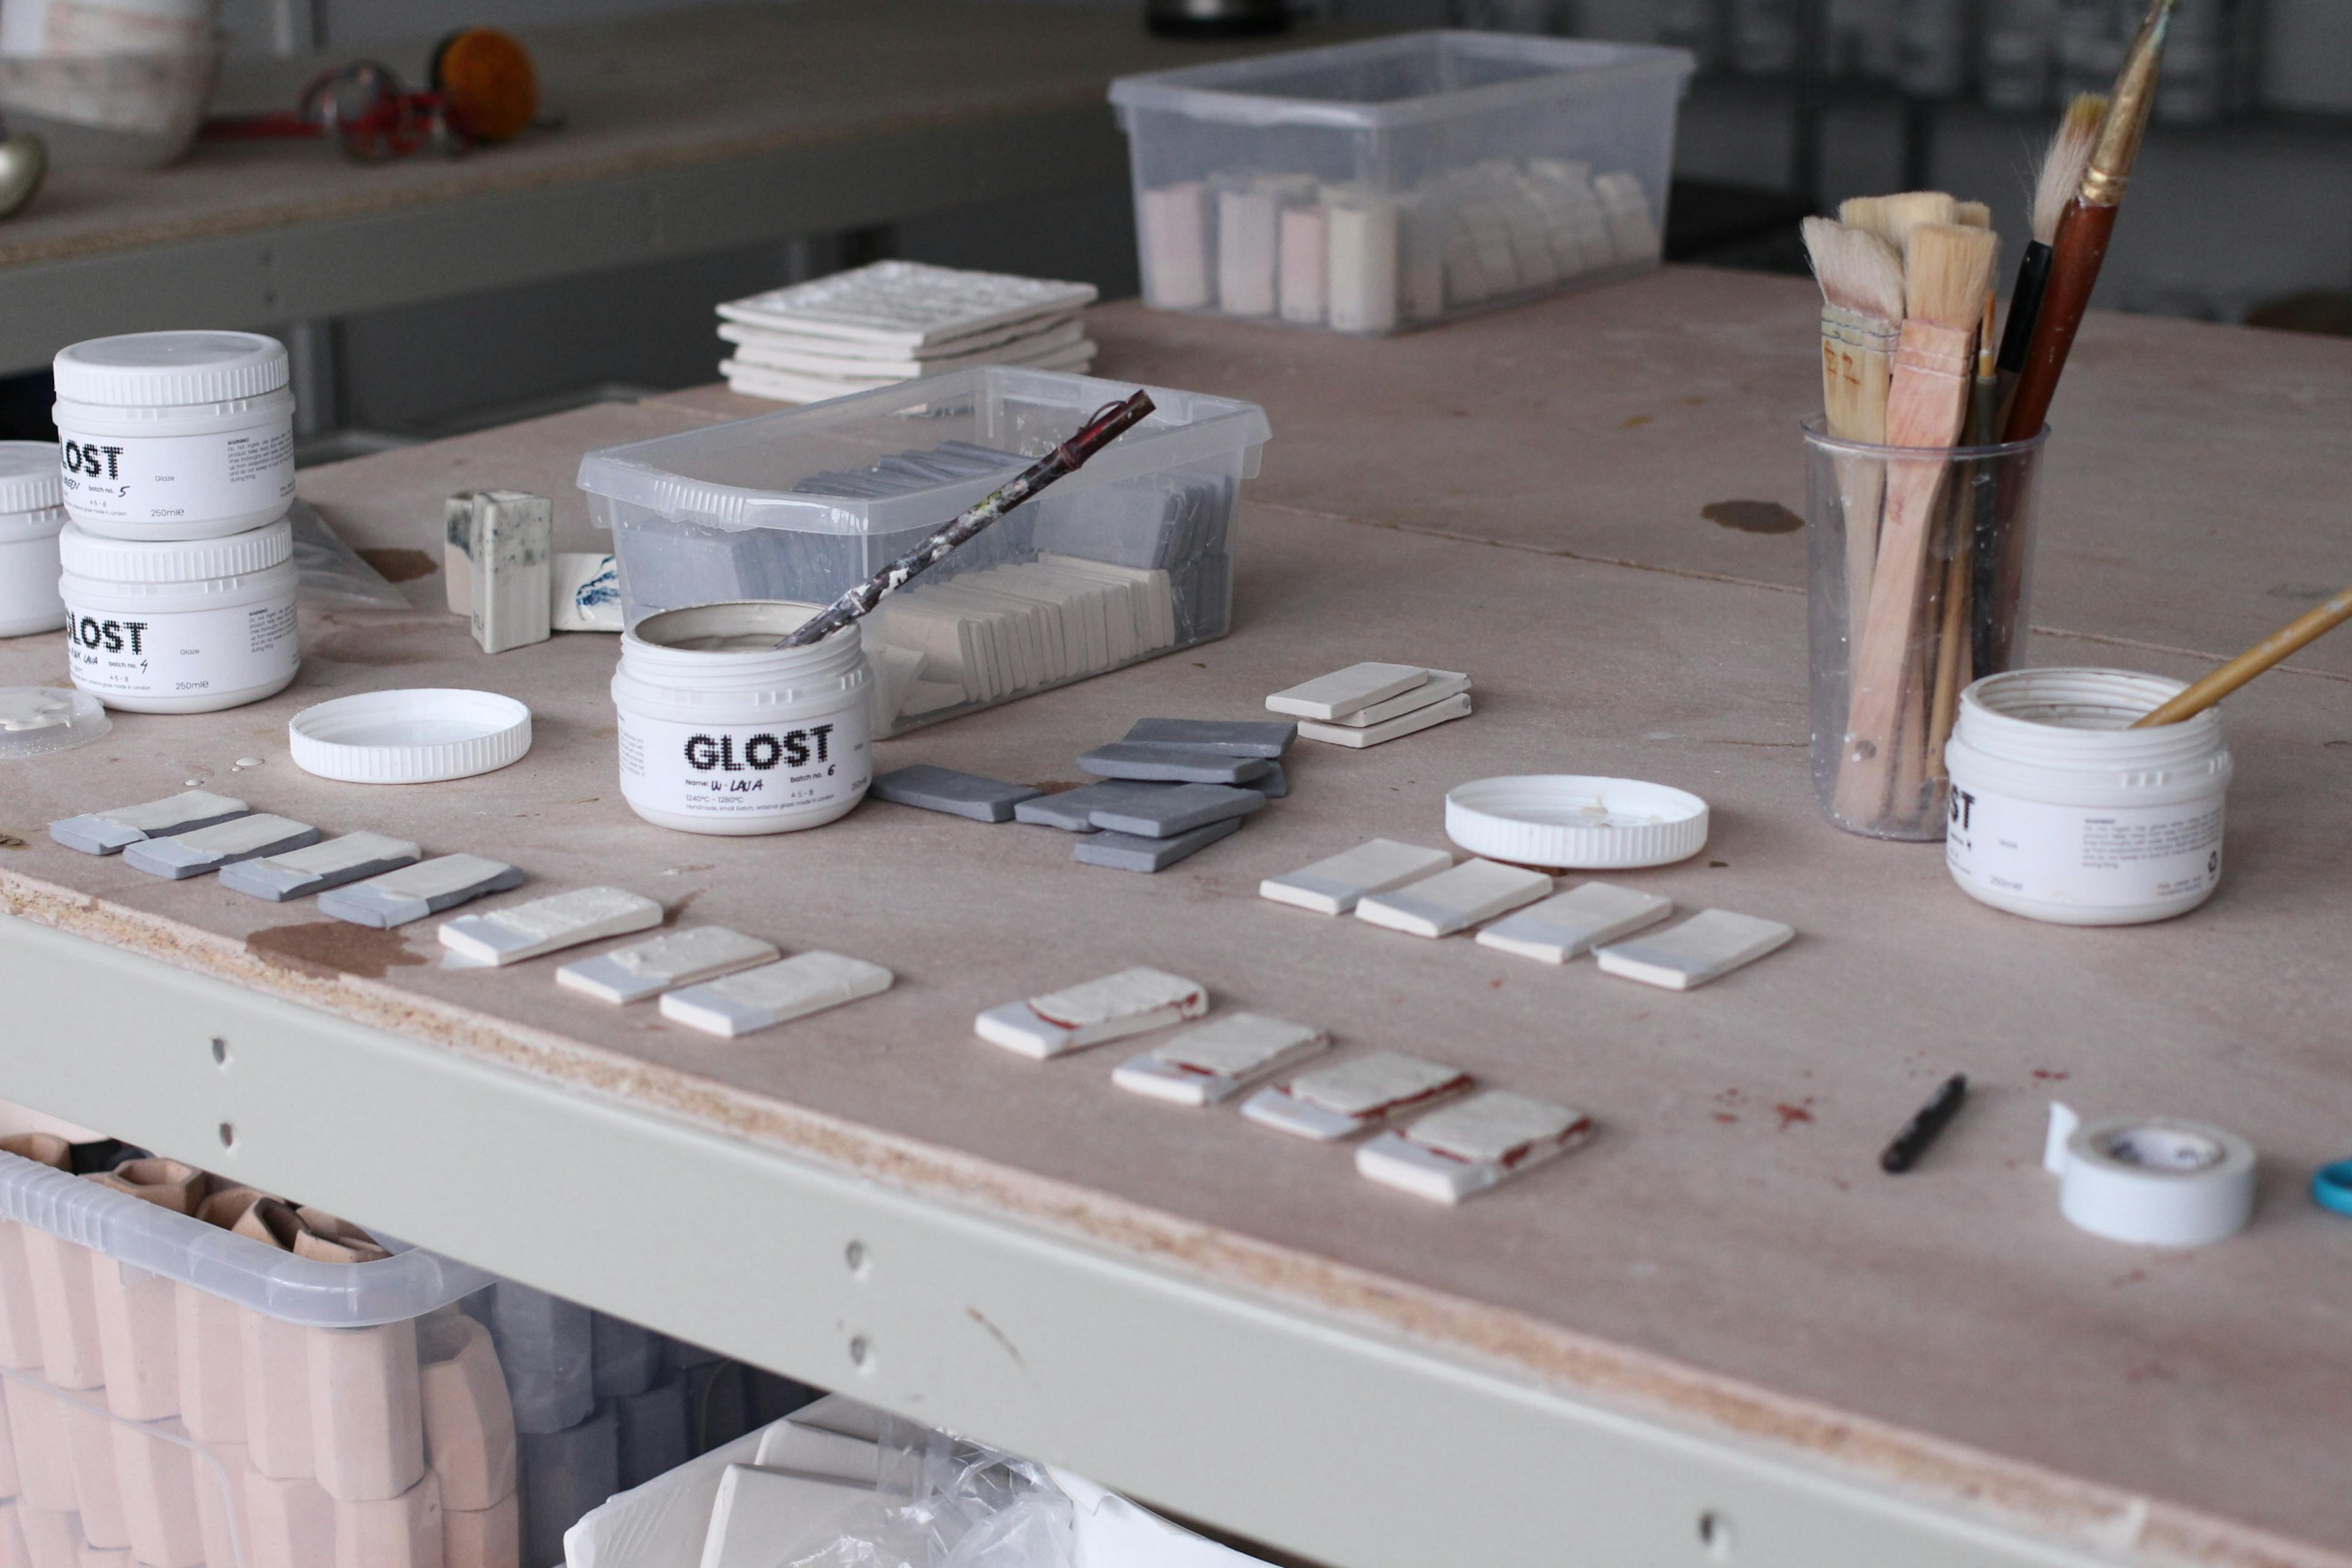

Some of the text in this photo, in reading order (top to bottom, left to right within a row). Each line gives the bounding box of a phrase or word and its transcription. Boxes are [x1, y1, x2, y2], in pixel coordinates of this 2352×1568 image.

[88, 484, 104, 493] batch
[118, 485, 130, 498] 5
[140, 659, 148, 674] 4
[684, 723, 834, 773] GLOST
[790, 774, 812, 783] batch
[827, 763, 835, 776] 6
[730, 778, 764, 792] LAVA
